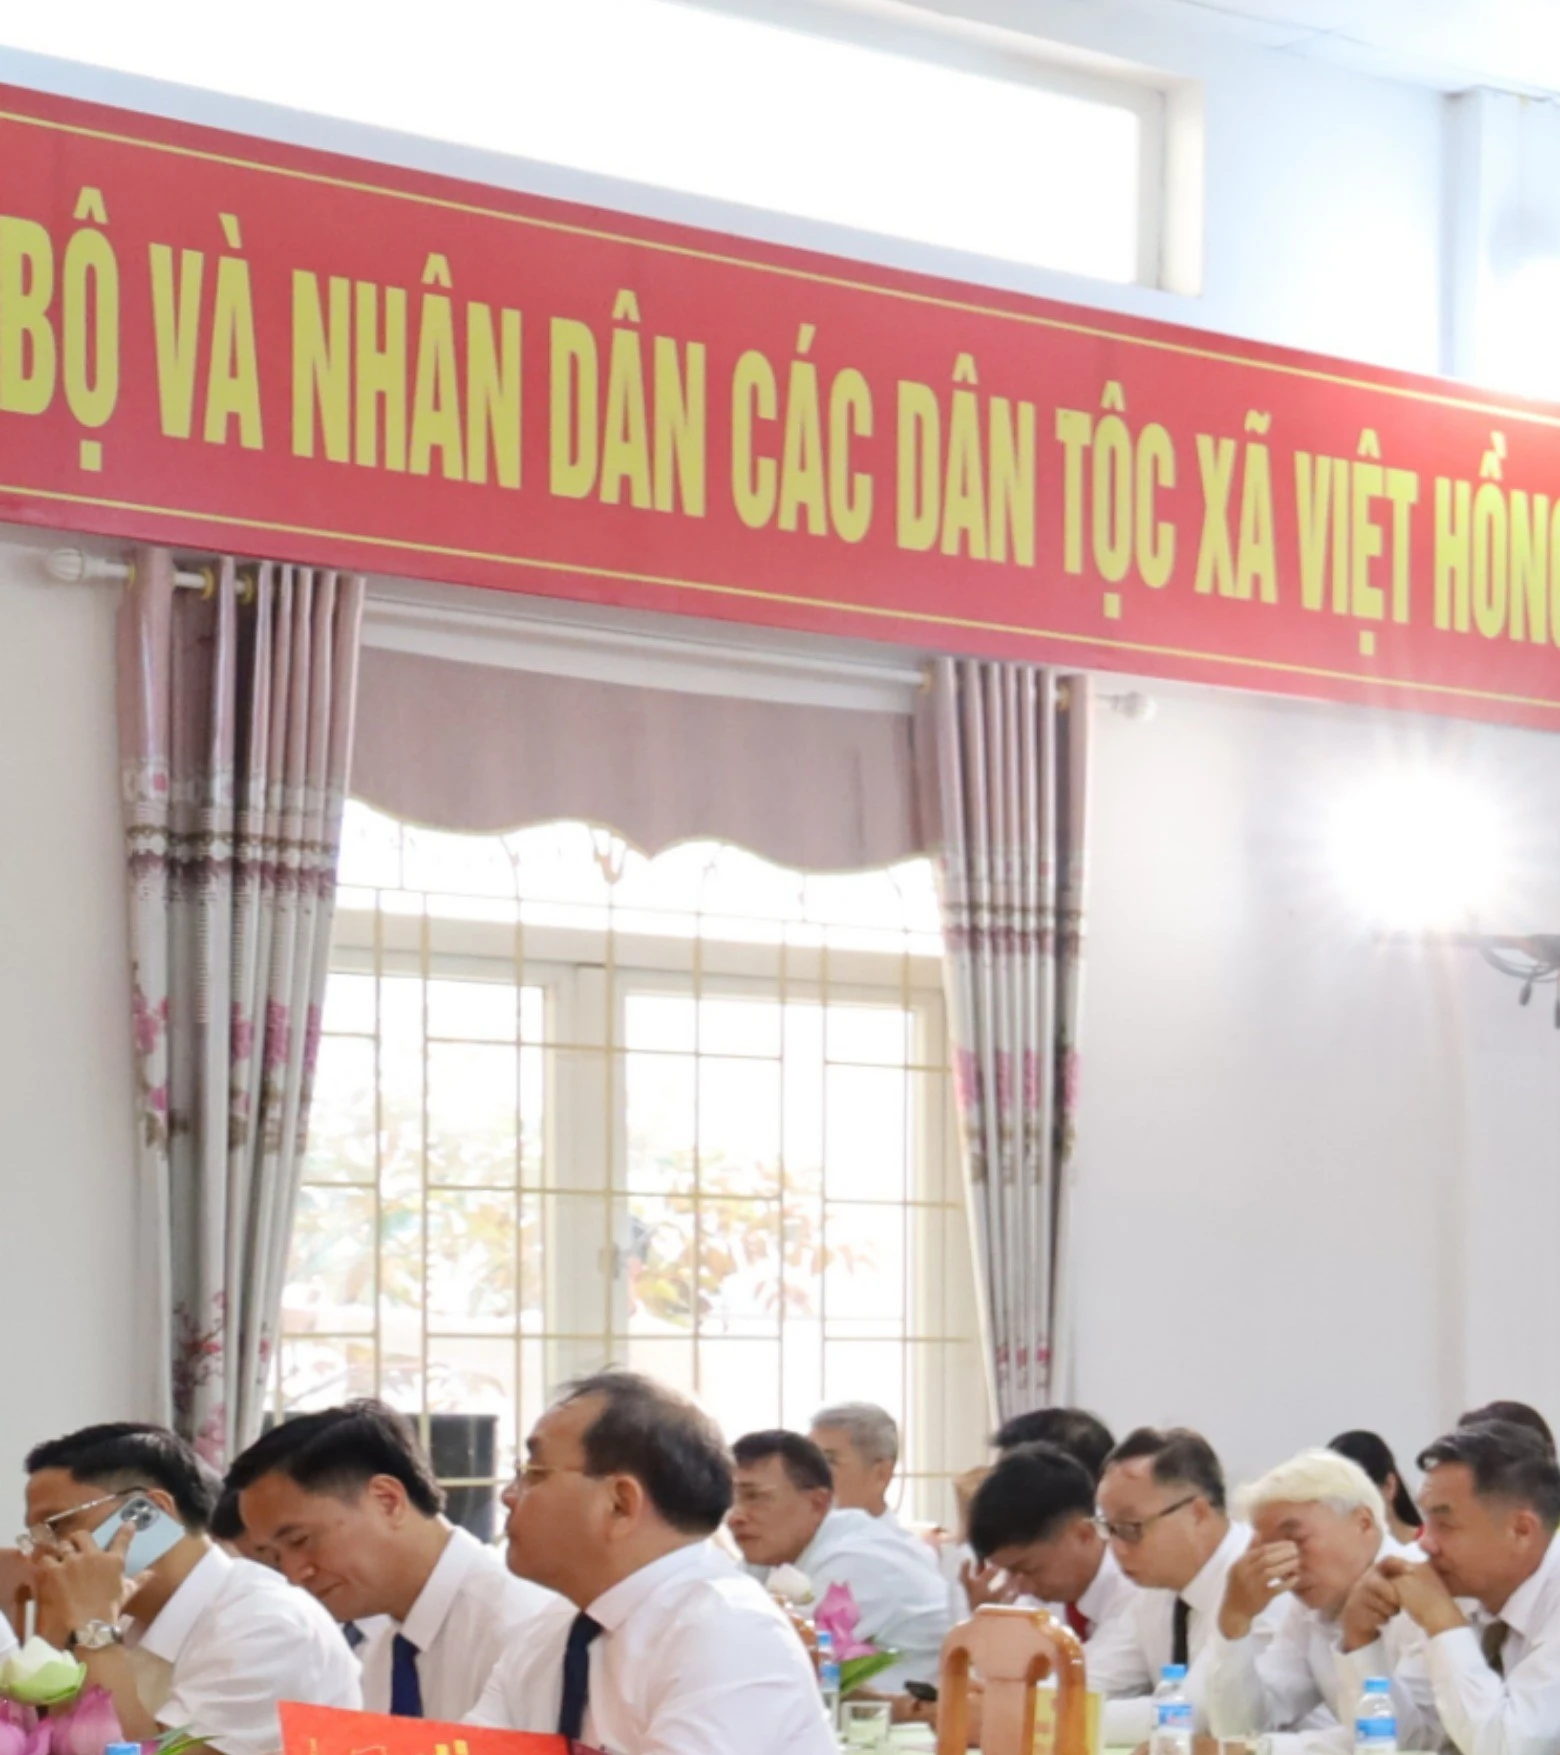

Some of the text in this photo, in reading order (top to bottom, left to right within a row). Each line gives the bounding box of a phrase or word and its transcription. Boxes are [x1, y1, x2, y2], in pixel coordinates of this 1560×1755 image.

[0, 186, 118, 470] BỘ
[148, 213, 263, 450] VÀ
[291, 252, 522, 489] NHÂN
[549, 289, 706, 517] DÂN
[731, 324, 872, 543] CÁC
[896, 354, 1035, 566] DÂN
[1056, 380, 1175, 618] TỘC
[1194, 409, 1277, 603] XÃ
[1293, 427, 1419, 654] VIỆT
